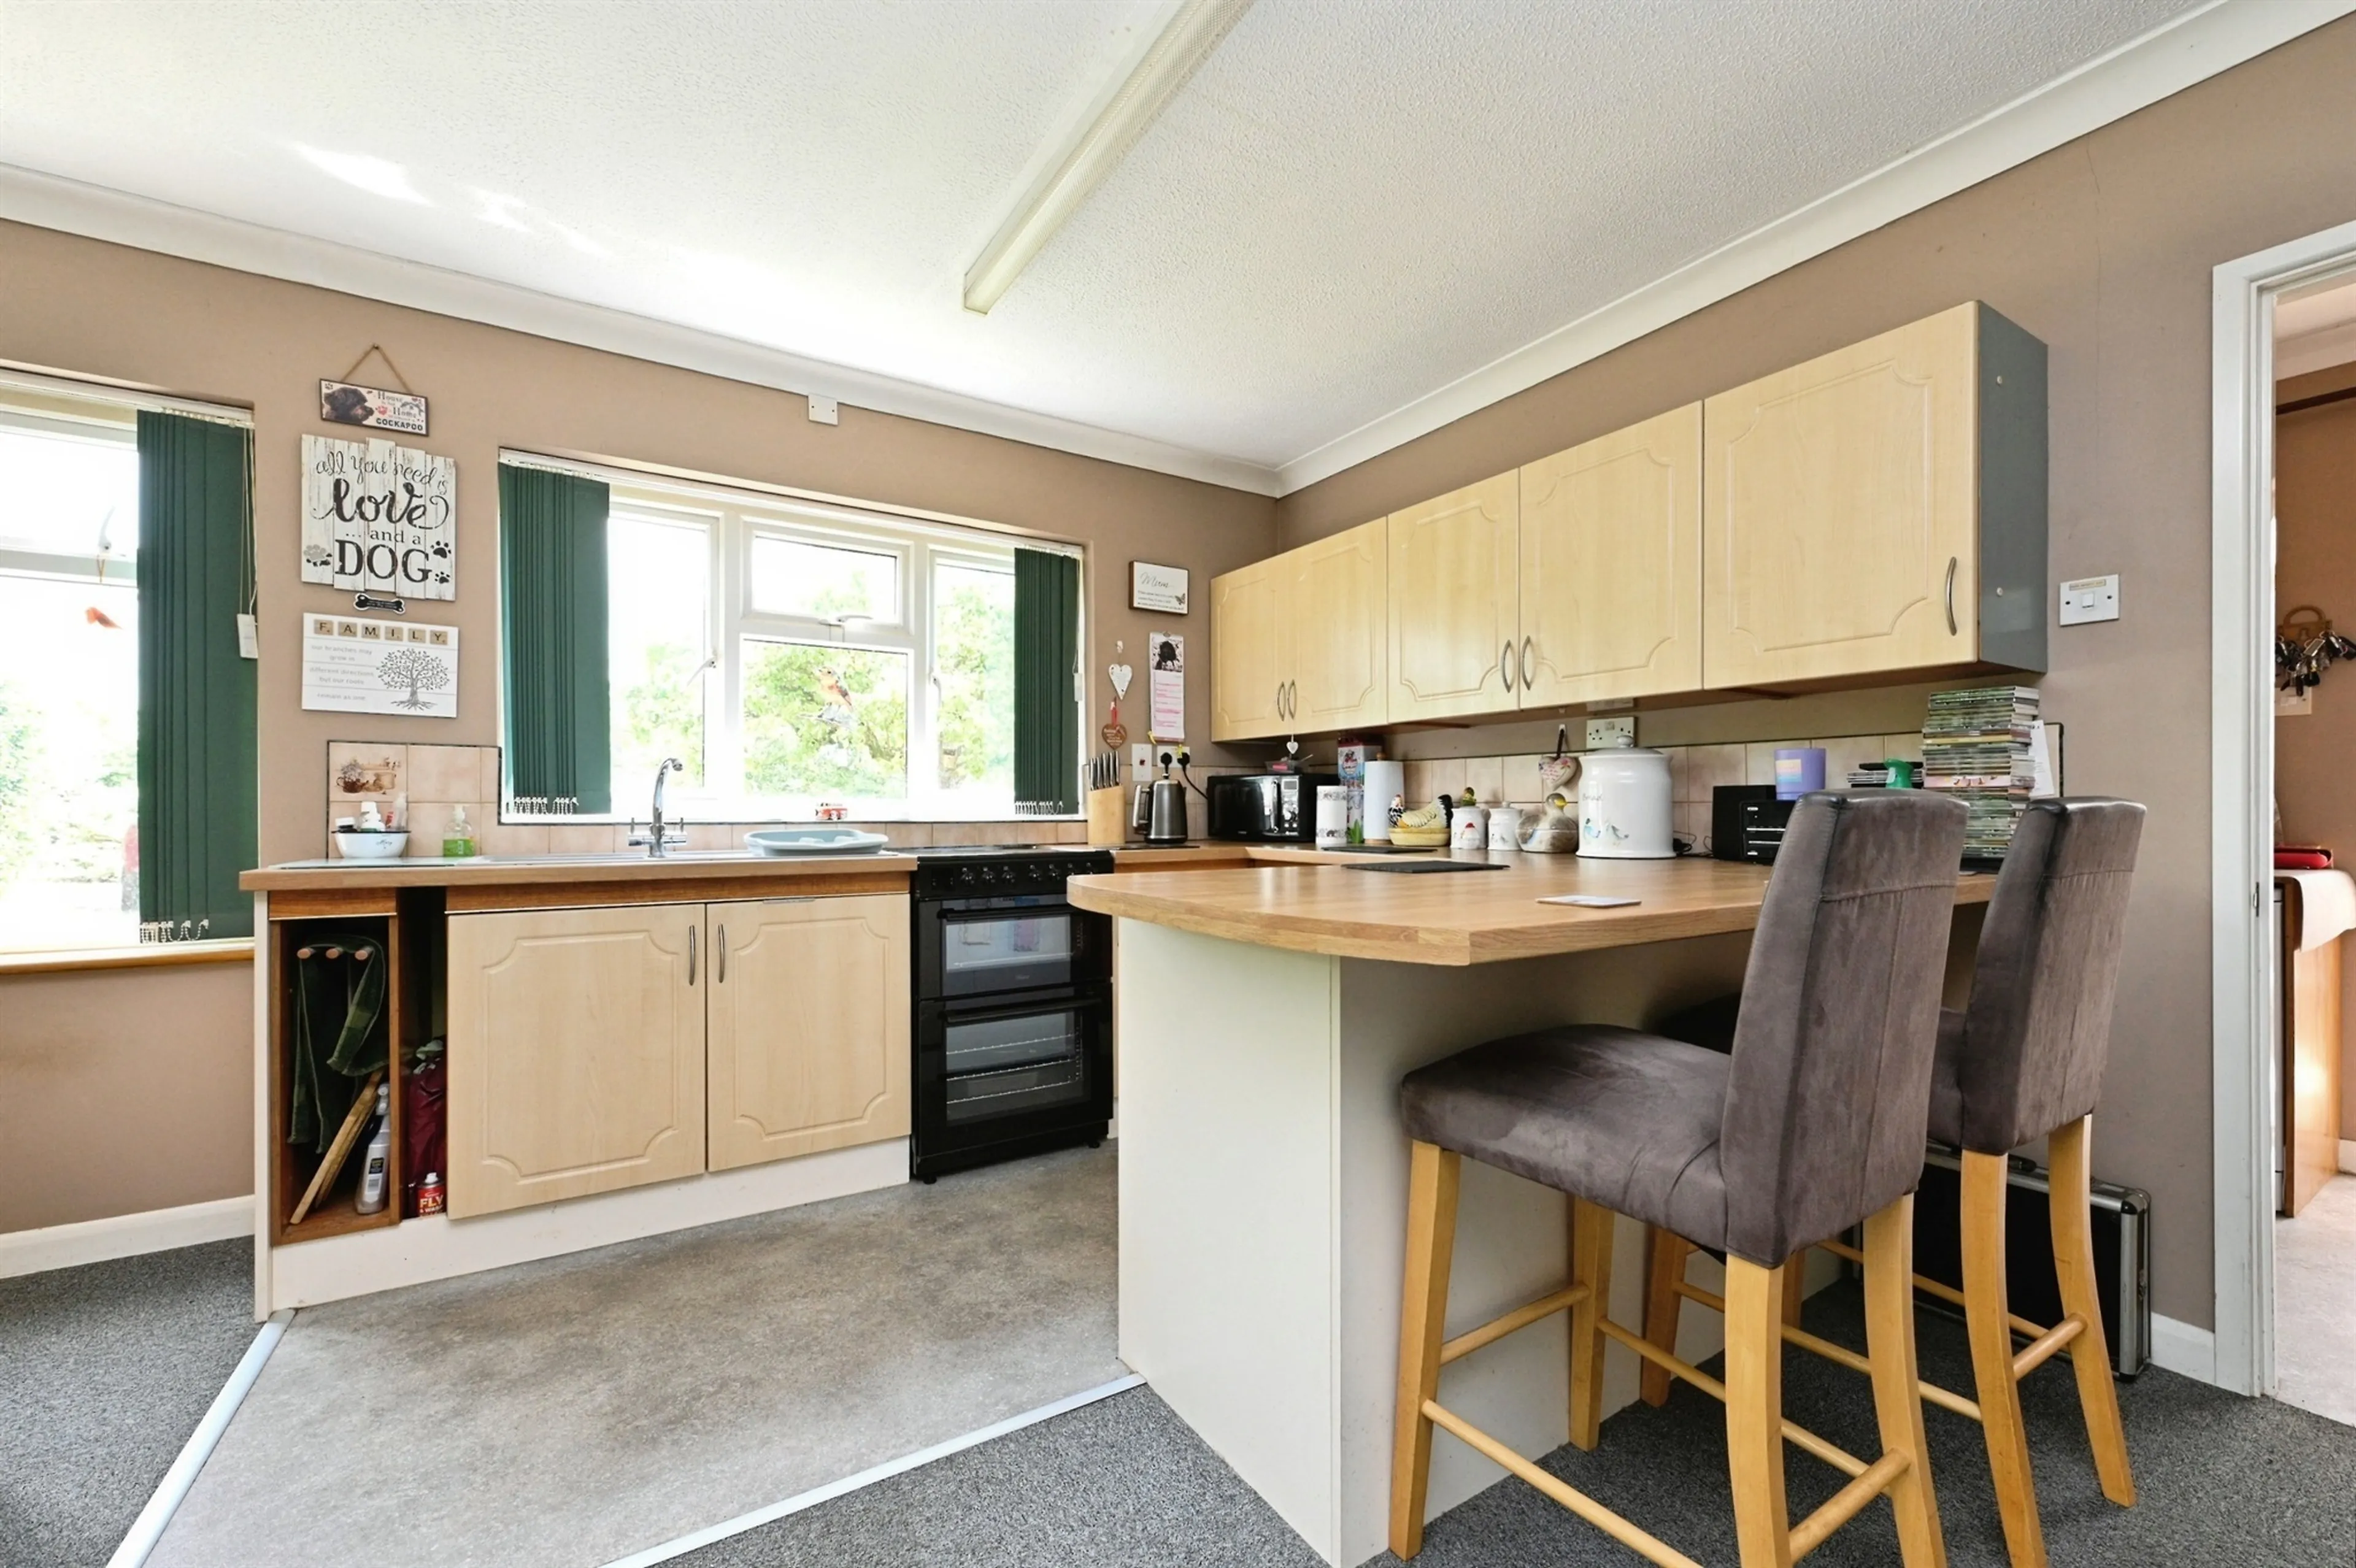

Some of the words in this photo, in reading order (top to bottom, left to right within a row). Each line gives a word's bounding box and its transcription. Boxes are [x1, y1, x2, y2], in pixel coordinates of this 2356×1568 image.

[376, 418, 423, 431] COCKAPOO
[316, 451, 345, 475] all
[351, 455, 387, 485] you
[393, 461, 437, 486] need
[437, 475, 448, 495] is
[310, 478, 449, 529] love
[370, 530, 404, 544] and
[412, 535, 421, 545] a
[335, 539, 432, 583] DOG
[420, 1194, 444, 1208] FLY
